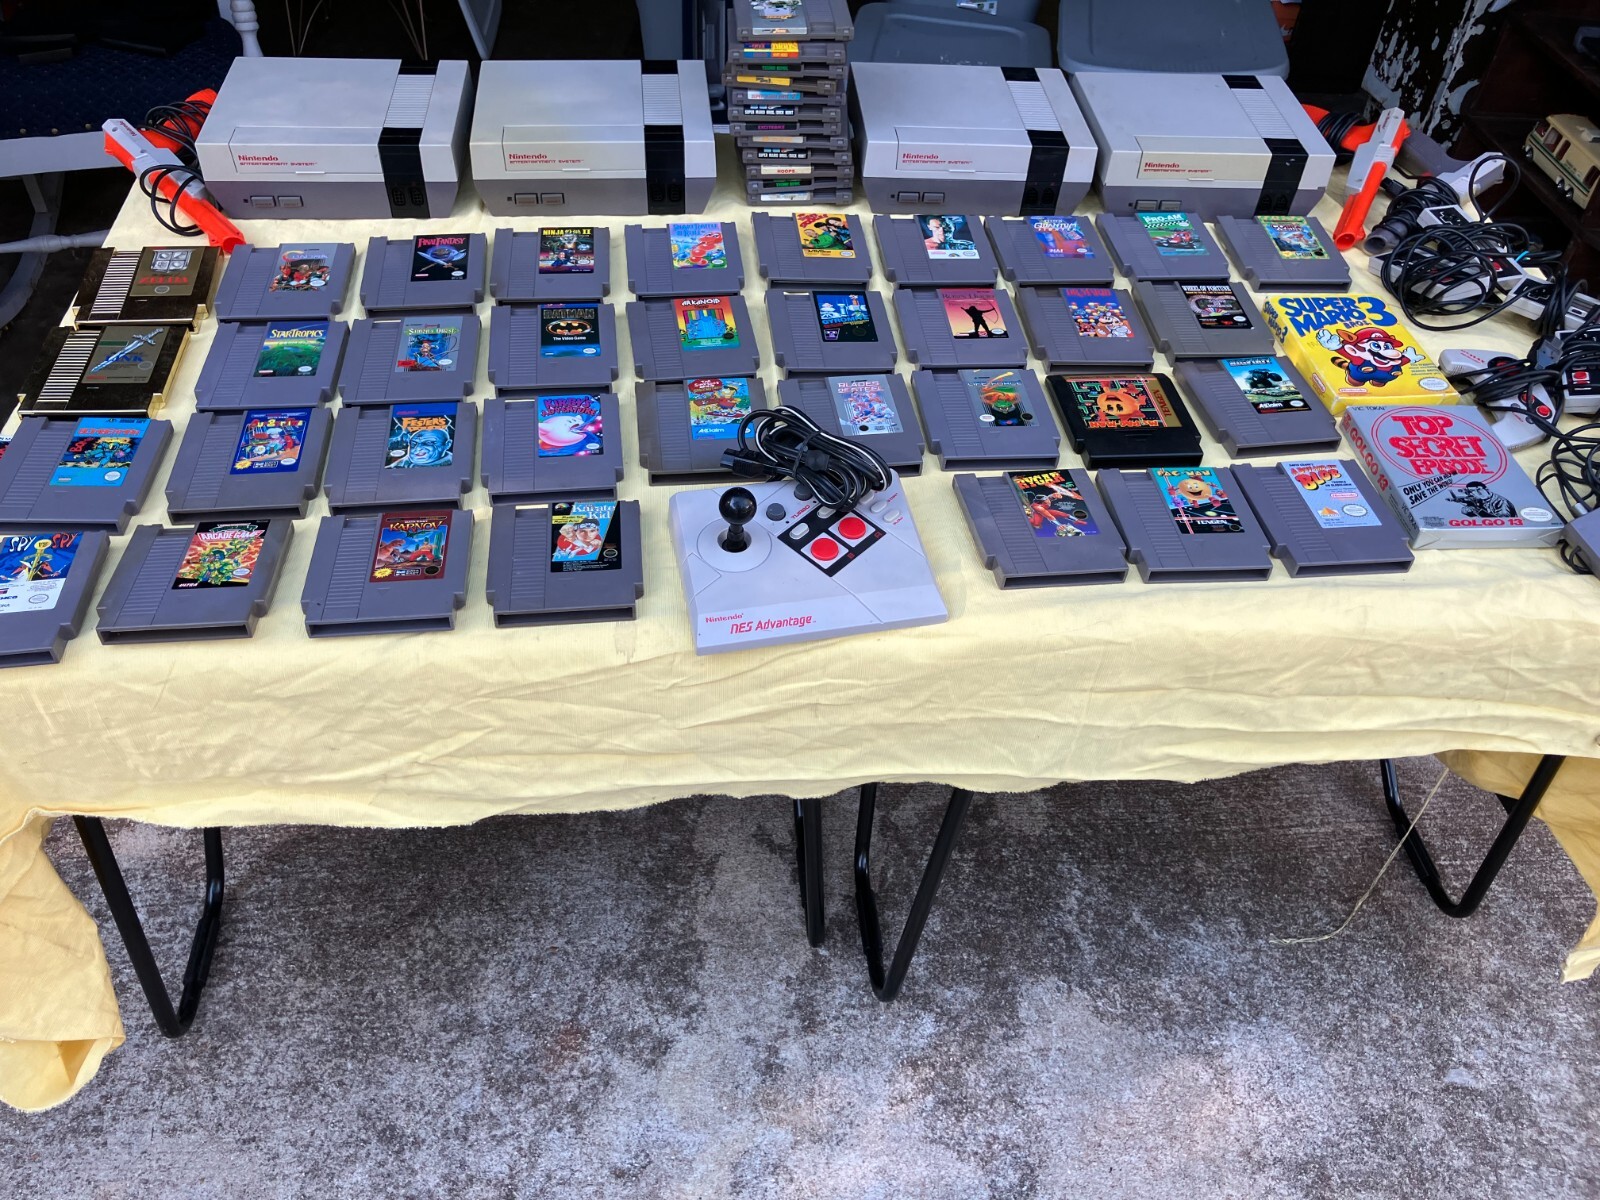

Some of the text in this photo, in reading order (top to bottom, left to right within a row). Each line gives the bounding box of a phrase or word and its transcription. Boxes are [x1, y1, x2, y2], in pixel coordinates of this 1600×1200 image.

[418, 237, 466, 248] FINAL FANTASY
[682, 298, 721, 306] ARKANOID
[1278, 297, 1356, 317] SUPER
[543, 308, 595, 319] BATMAN
[1359, 296, 1398, 327] 3
[1289, 307, 1367, 337] MARIO
[1344, 320, 1371, 329] BROS.
[1152, 389, 1172, 417] TENGEN
[402, 417, 447, 430] FESTER'S
[1391, 416, 1453, 436] TOP
[1389, 436, 1488, 458] SECRET
[1349, 428, 1389, 491] GOLGO 13
[1410, 459, 1494, 475] EPISODE
[1013, 471, 1065, 489] RYGAR
[1295, 469, 1342, 490] BLOB
[1403, 483, 1422, 495] ONLY
[1422, 479, 1434, 488] YOU
[1409, 491, 1427, 505] SAVE
[1427, 485, 1438, 495] THE
[572, 504, 615, 513] Karate
[791, 505, 810, 519] TURBO
[389, 521, 442, 532] KARNOV
[1449, 518, 1505, 527] GOLGO
[1508, 518, 1523, 526] 13
[9, 536, 37, 552] SPY
[52, 532, 78, 548] SPY
[201, 532, 234, 540] ARCADE
[705, 613, 742, 623] Nintendo
[755, 615, 812, 631] Advantage
